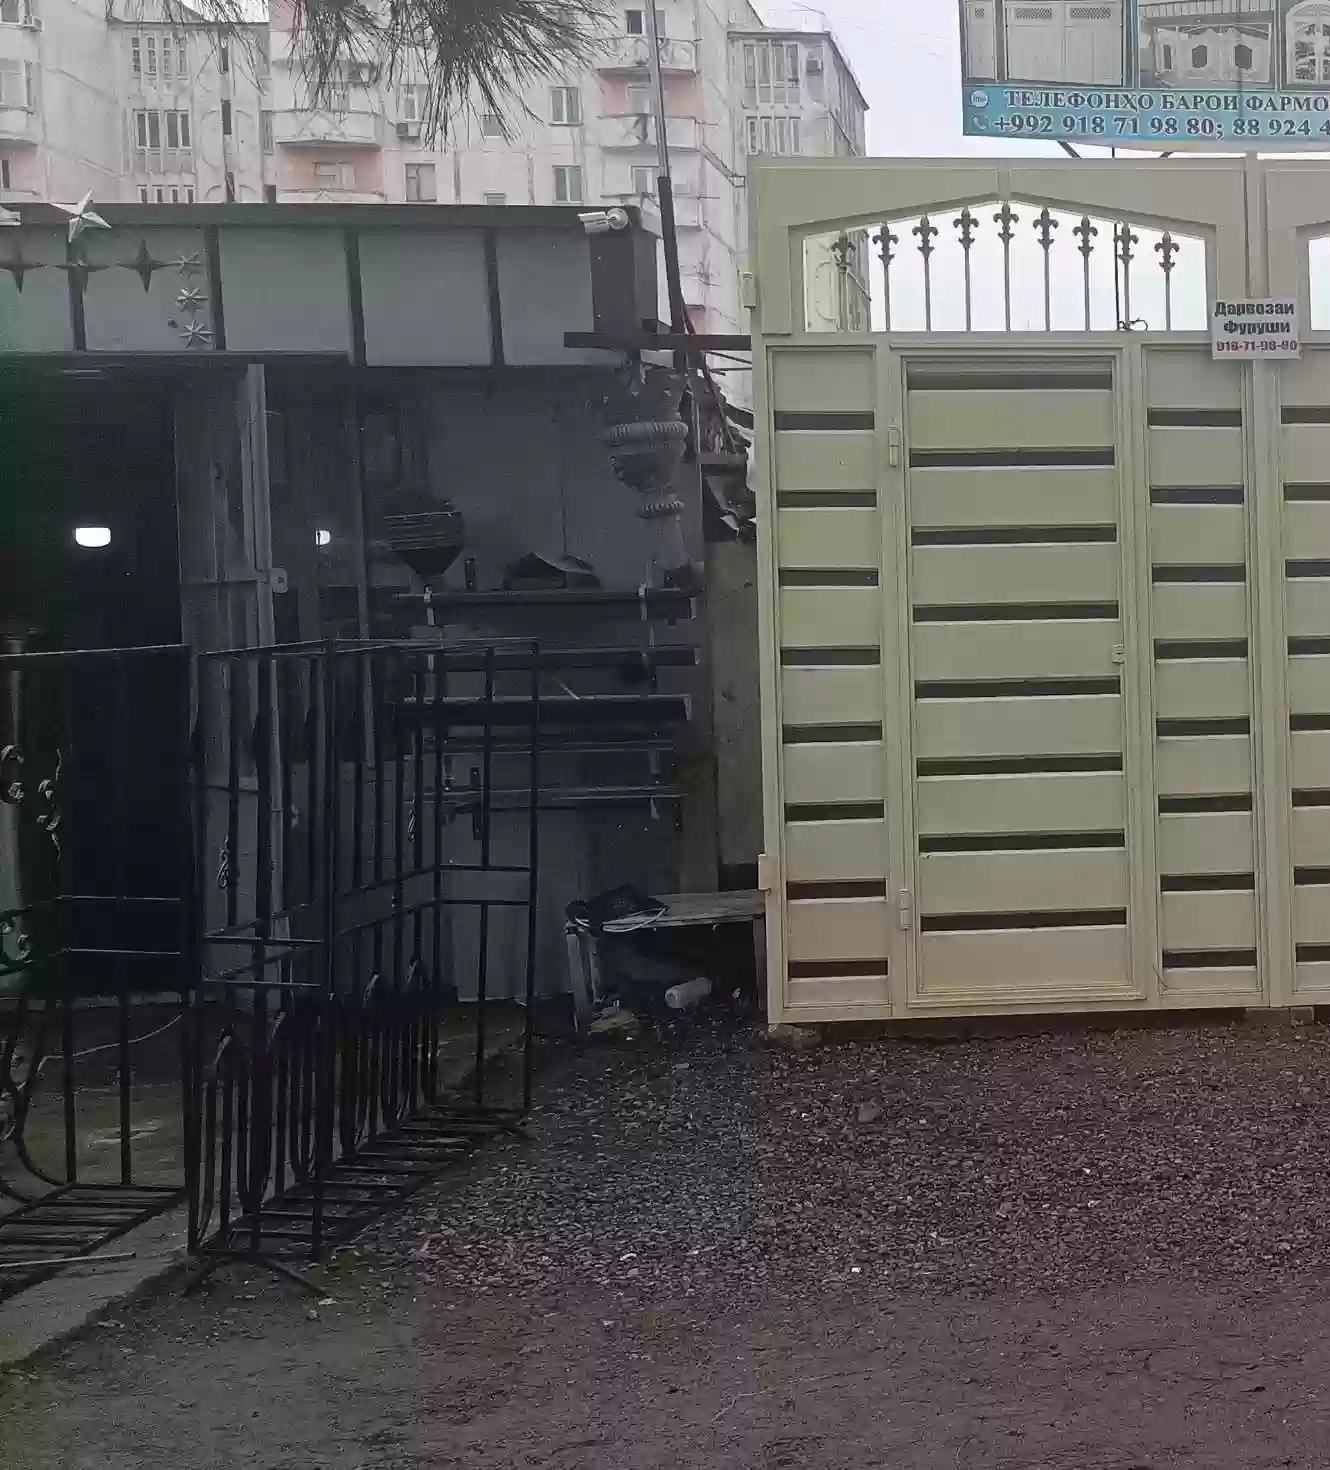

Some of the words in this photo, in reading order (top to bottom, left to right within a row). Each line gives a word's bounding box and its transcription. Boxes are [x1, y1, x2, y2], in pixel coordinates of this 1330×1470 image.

[993, 115, 1053, 135] +992
[1062, 116, 1105, 134] 918
[1113, 117, 1140, 134] 71
[1150, 117, 1178, 135] 98
[1233, 119, 1260, 136] 88
[1268, 119, 1311, 136] 924
[1223, 320, 1291, 335] Фуруши
